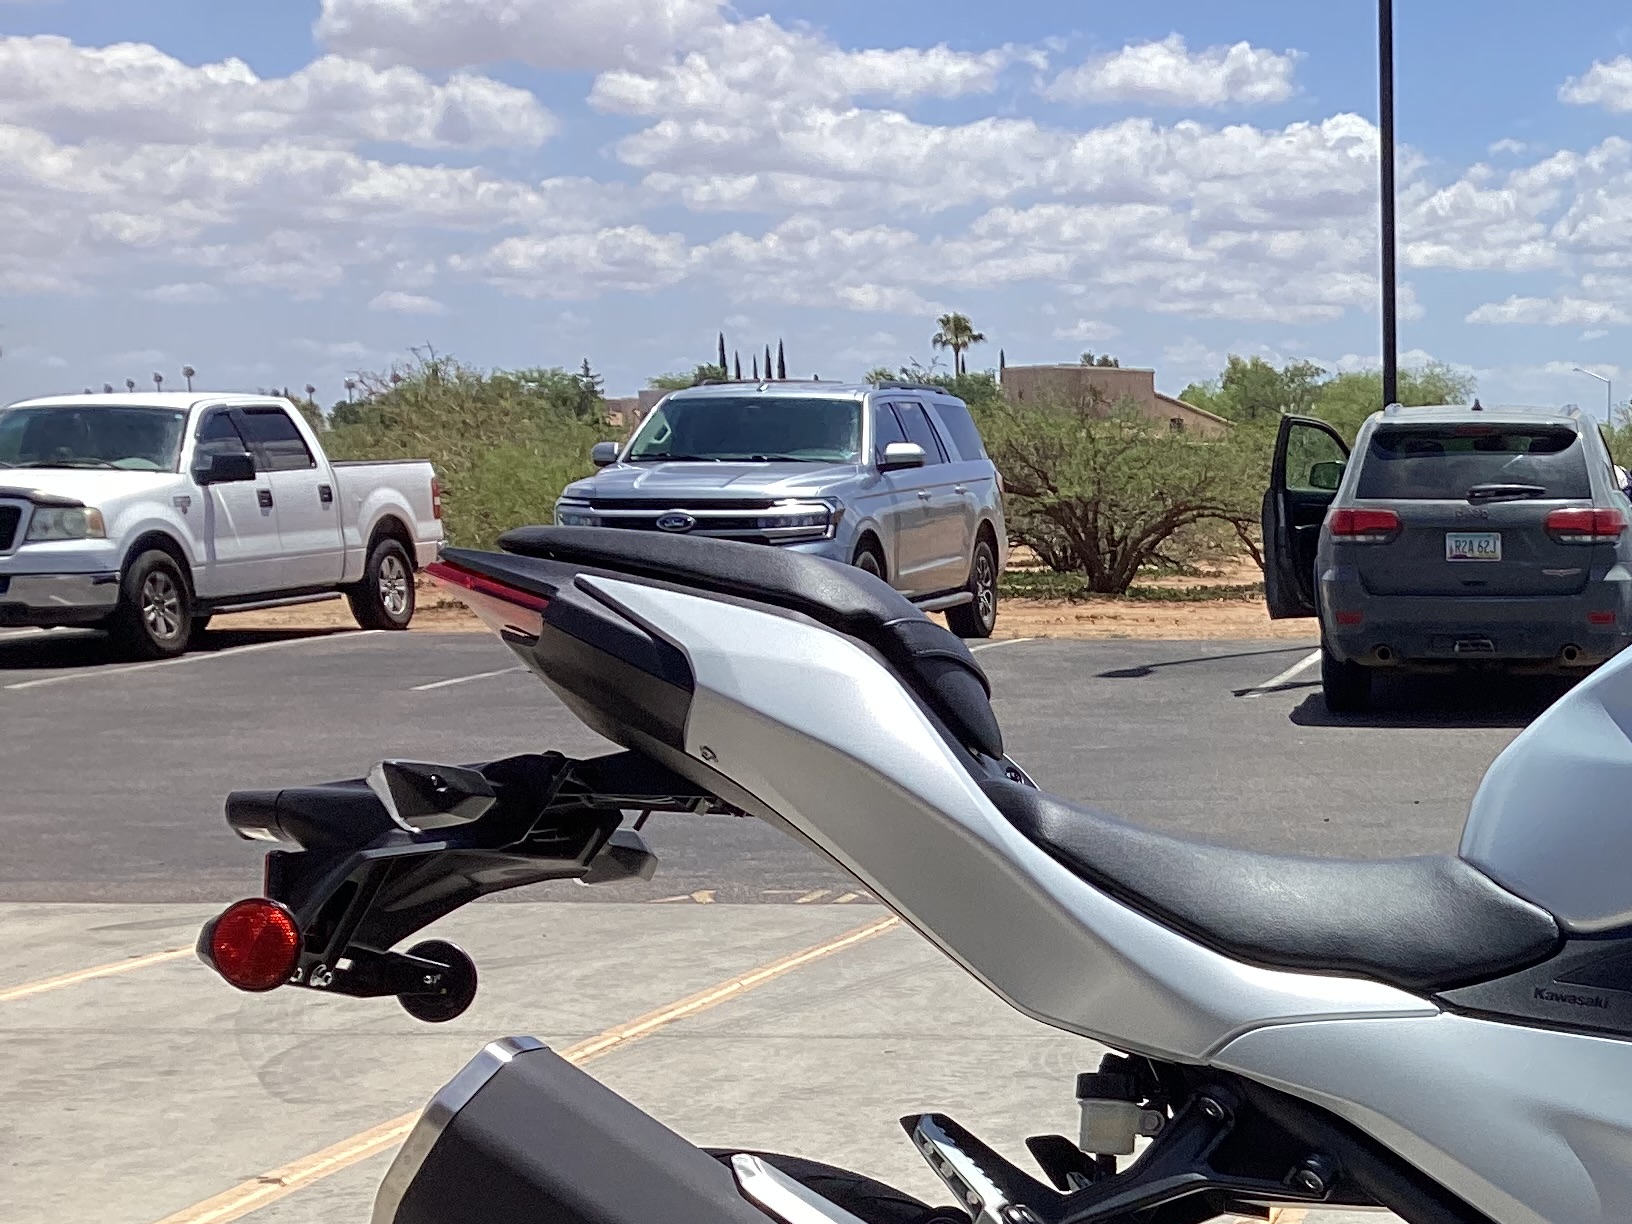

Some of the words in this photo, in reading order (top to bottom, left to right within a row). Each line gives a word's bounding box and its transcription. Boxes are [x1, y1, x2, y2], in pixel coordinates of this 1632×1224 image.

[1454, 539, 1475, 554] R2A
[1477, 539, 1497, 554] 62J
[1533, 987, 1609, 1009] Kawasaki
